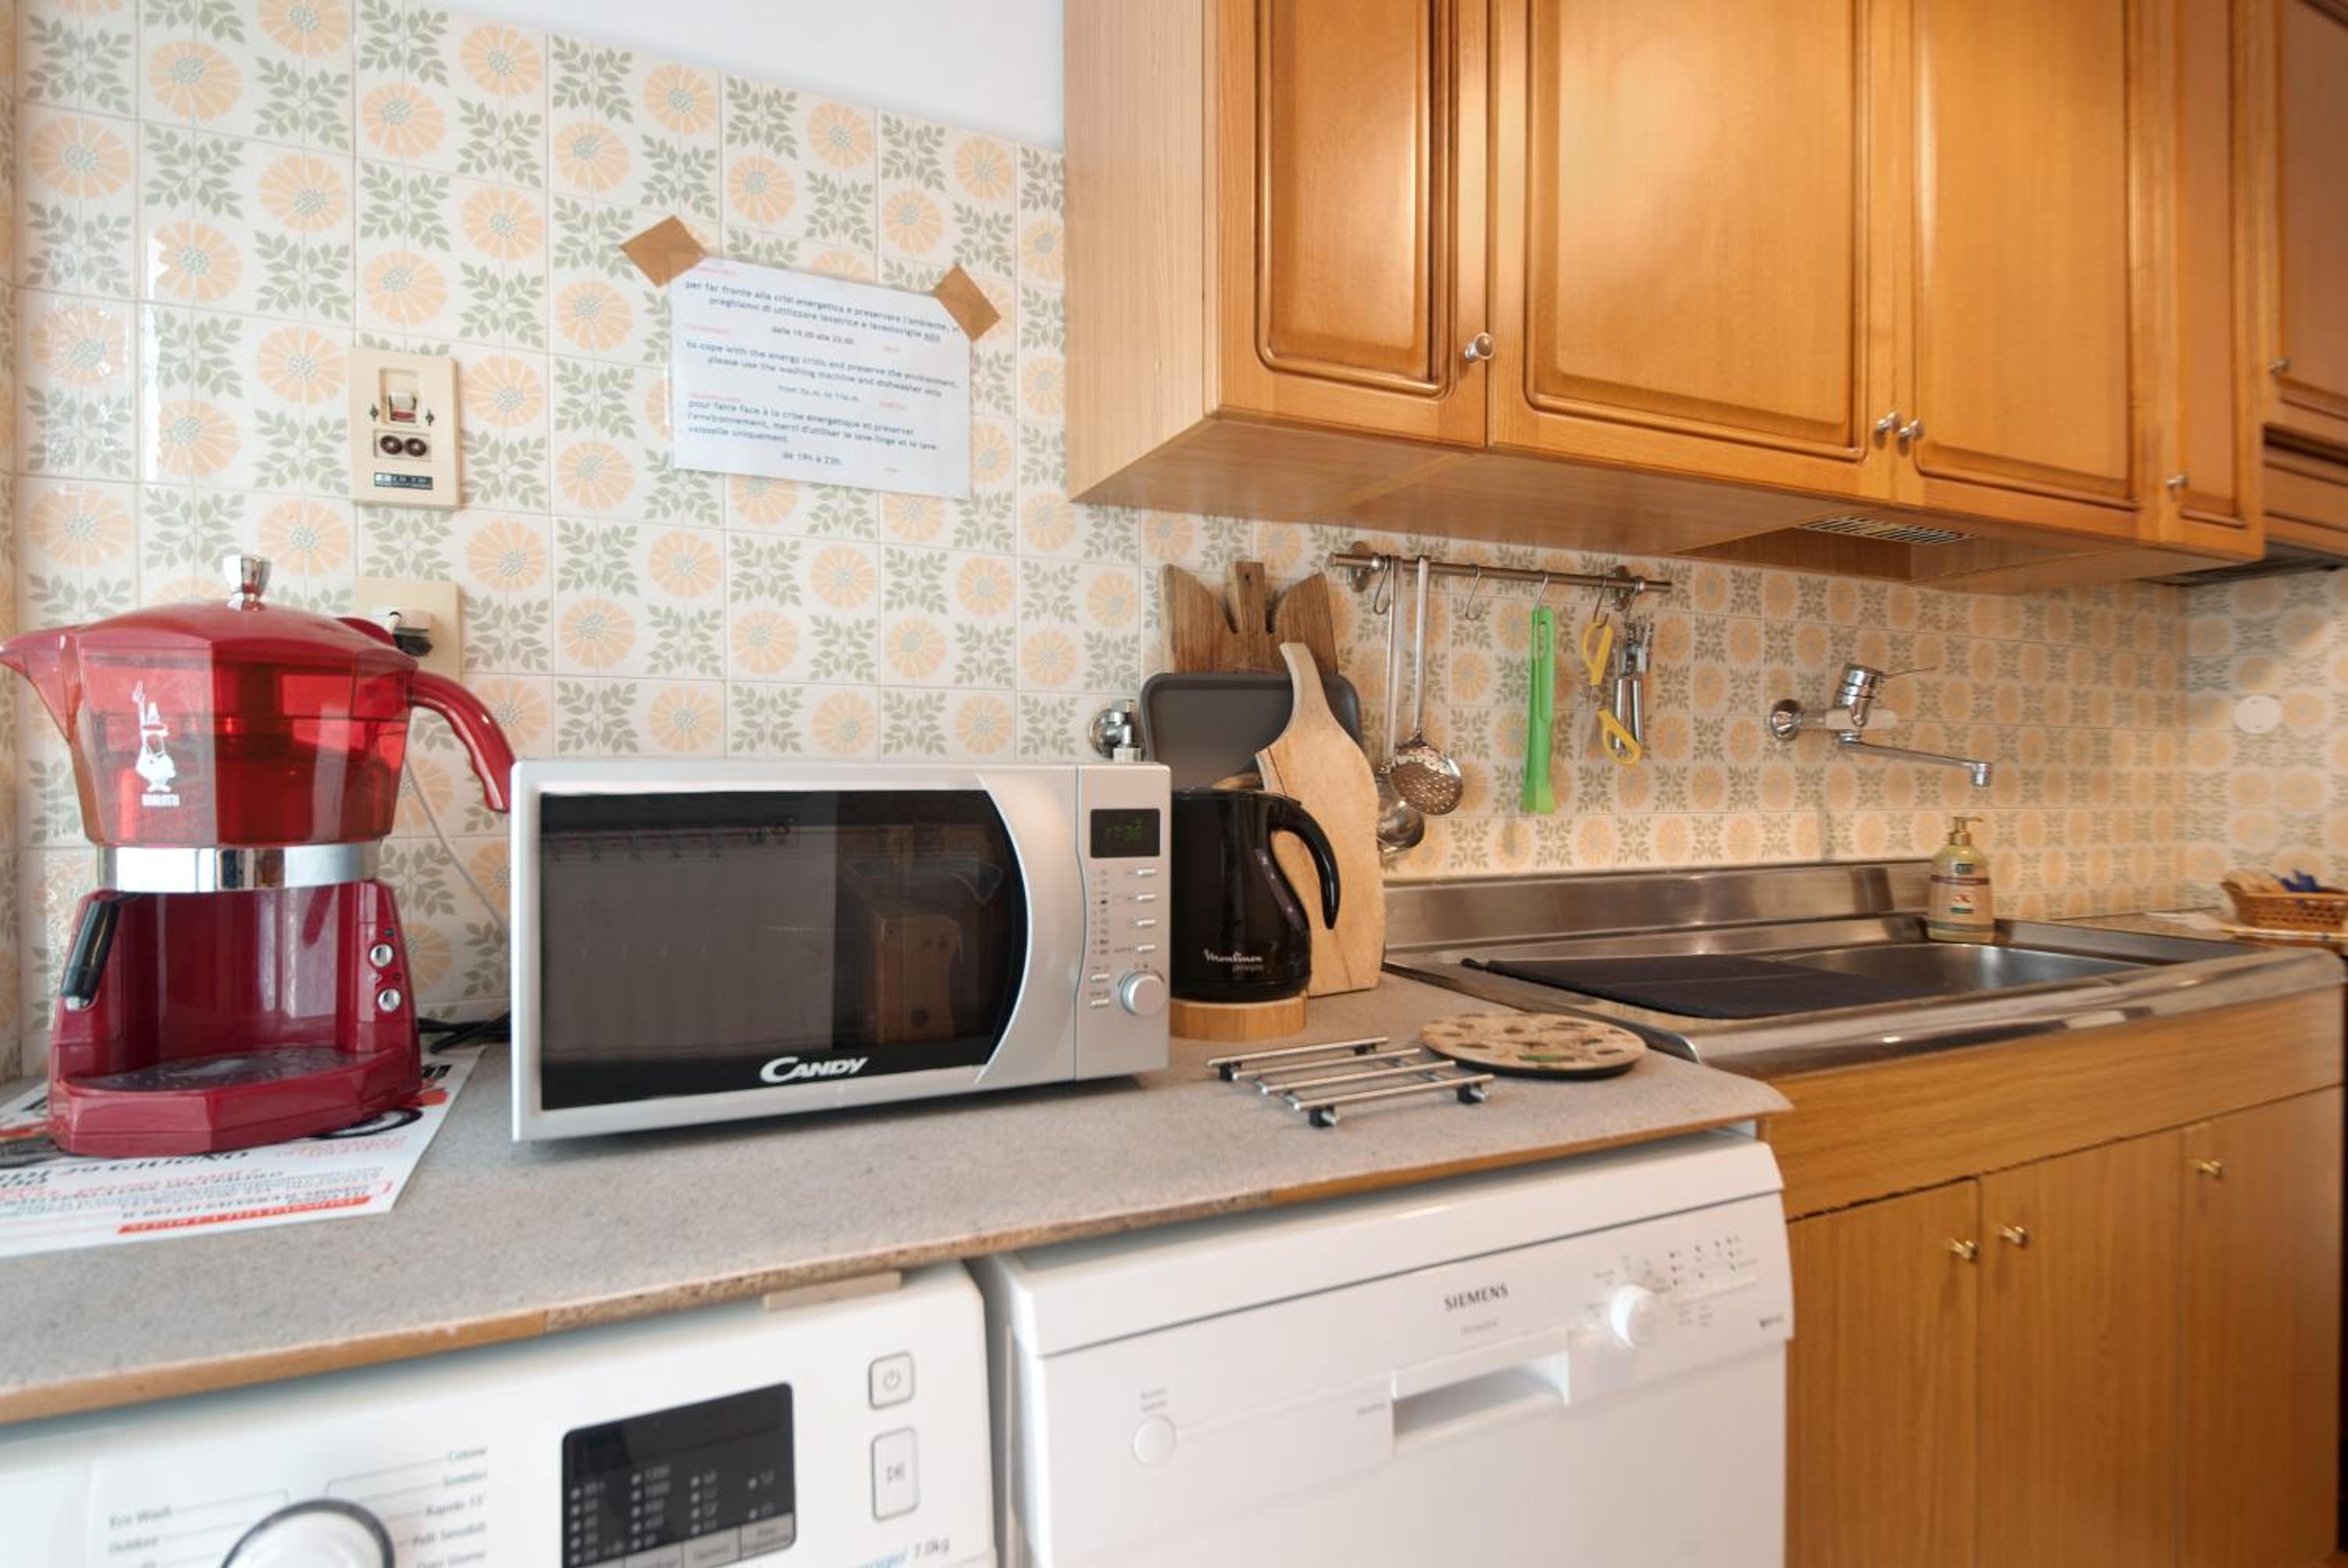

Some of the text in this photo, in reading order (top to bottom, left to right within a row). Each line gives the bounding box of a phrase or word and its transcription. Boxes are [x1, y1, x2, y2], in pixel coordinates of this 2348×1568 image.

[768, 352, 799, 365] energy
[760, 1056, 869, 1083] CANDY
[1444, 1282, 1509, 1313] SIEMENS
